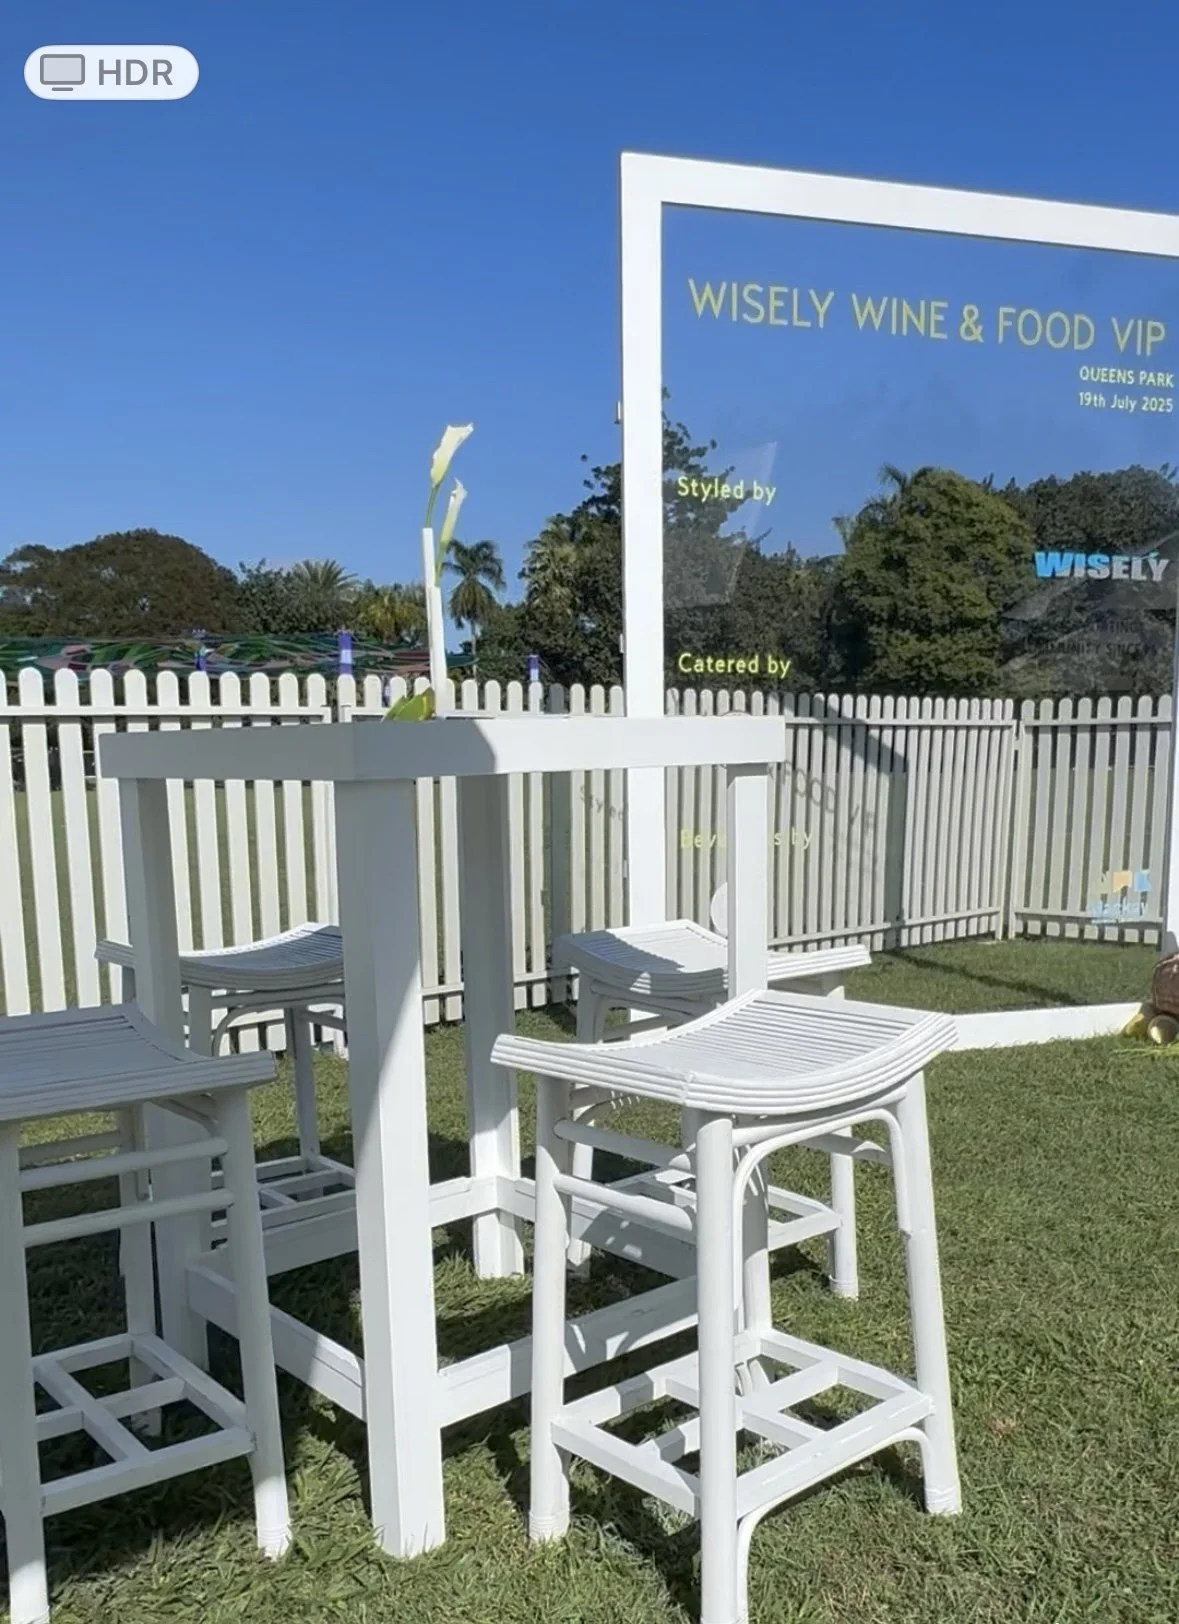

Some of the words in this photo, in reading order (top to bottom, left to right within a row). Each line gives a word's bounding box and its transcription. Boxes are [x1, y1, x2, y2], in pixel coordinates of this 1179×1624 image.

[688, 278, 835, 329] WISELY
[852, 293, 949, 340] WINE
[959, 303, 985, 344] &
[998, 306, 1095, 350] FOOD
[1111, 316, 1166, 357] VIP
[1079, 366, 1135, 385] QUEENS
[1139, 371, 1174, 388] PARK
[1079, 391, 1106, 408] 19th
[1111, 394, 1137, 413] July
[1142, 397, 1174, 412] 2025
[678, 475, 745, 503] Styled
[752, 480, 777, 506] by
[1034, 551, 1170, 582] WISELY
[678, 652, 760, 673] Catered
[767, 655, 791, 679] by
